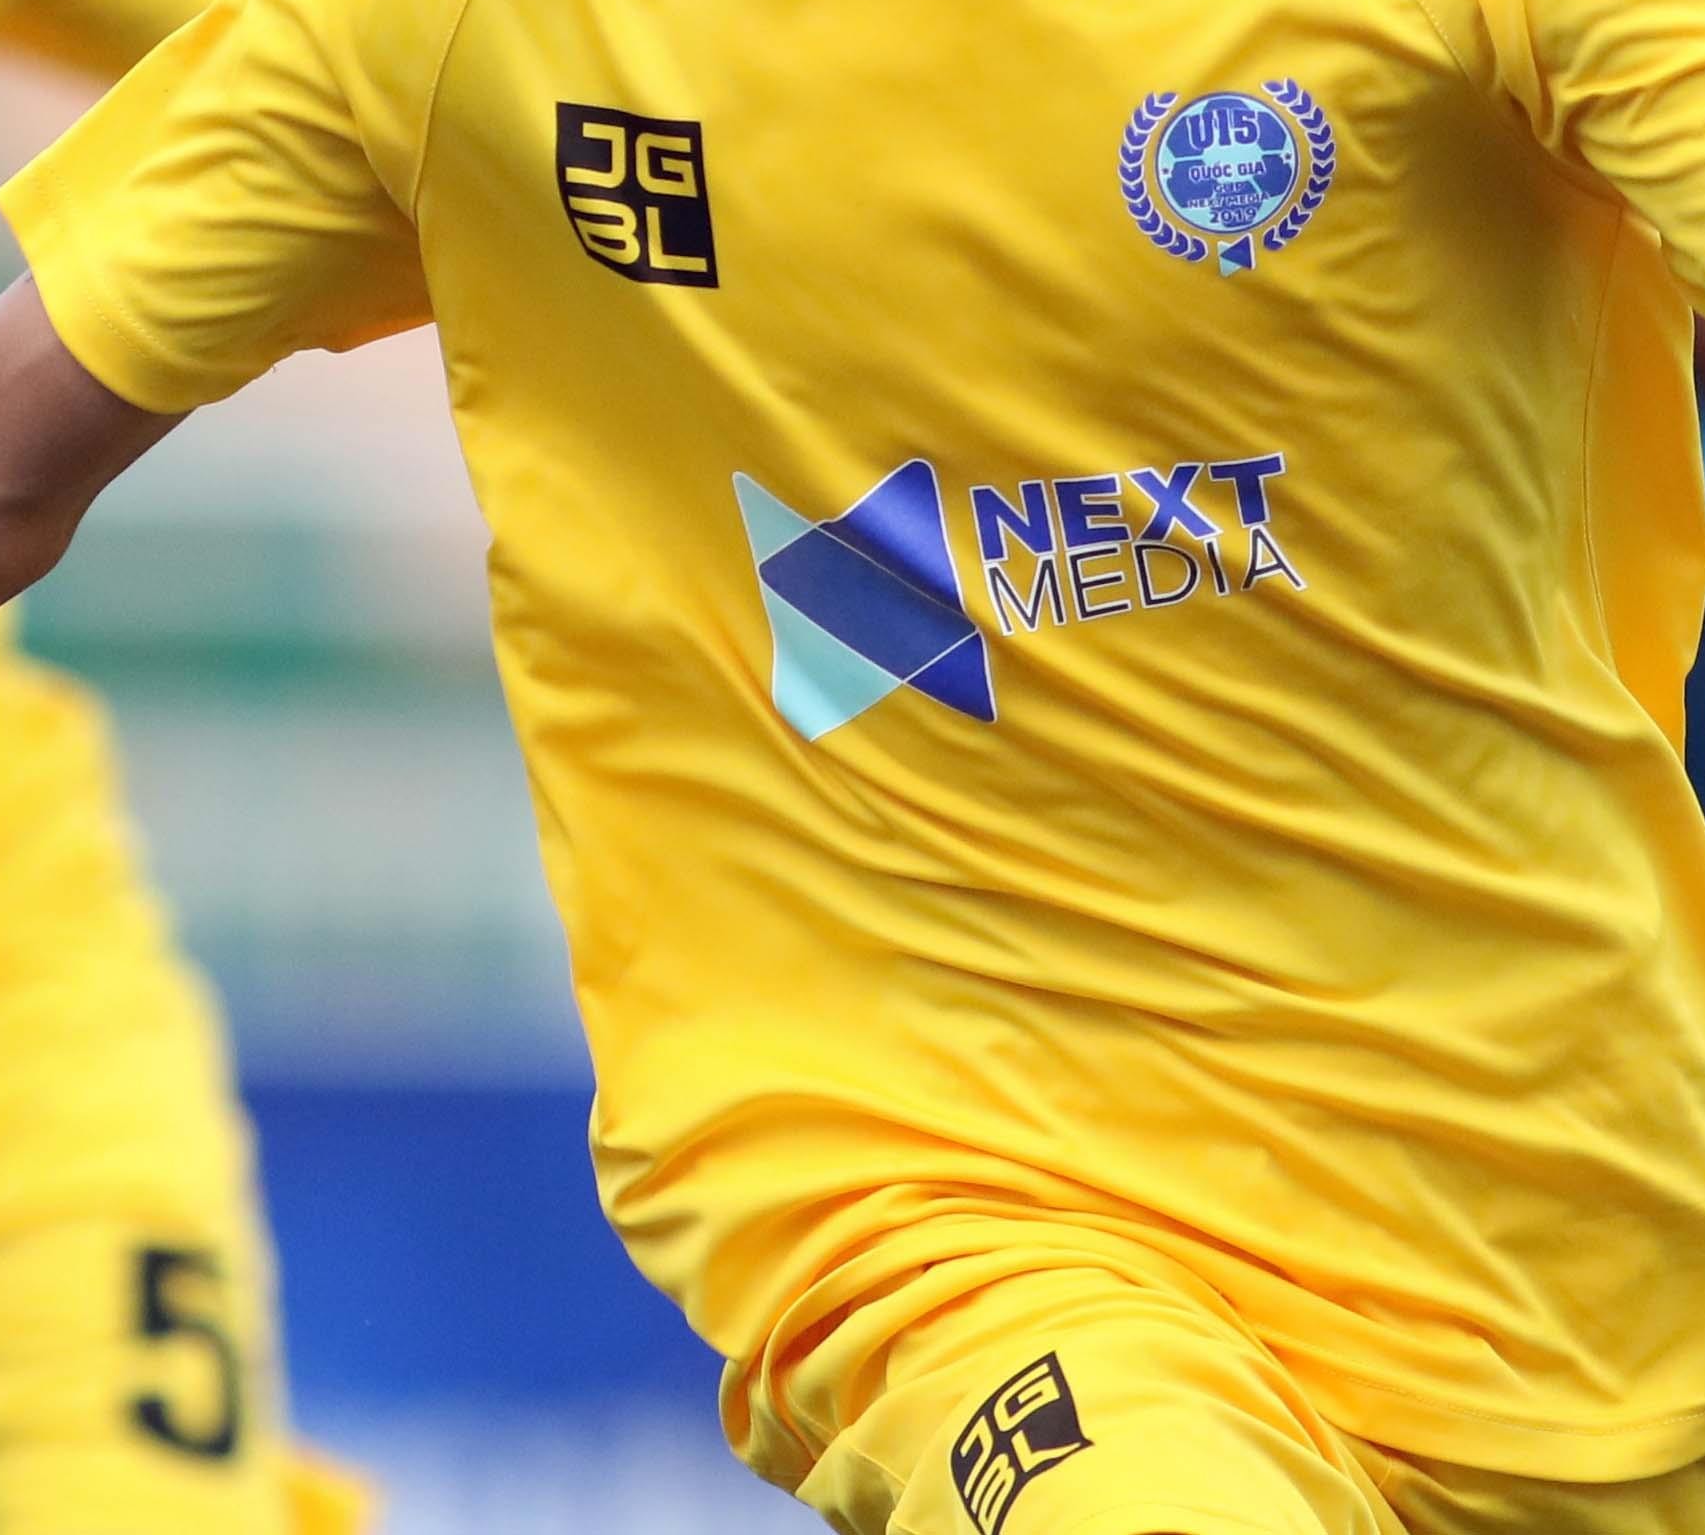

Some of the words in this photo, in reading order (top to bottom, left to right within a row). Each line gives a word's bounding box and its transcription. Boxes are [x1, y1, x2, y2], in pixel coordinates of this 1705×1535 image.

[565, 122, 698, 199] JG
[1186, 107, 1260, 151] U15
[1238, 160, 1267, 177] GIA
[1210, 207, 1258, 224] 2019
[969, 451, 1286, 565] NEXT
[984, 524, 1307, 636] MEDIA
[134, 1246, 240, 1459] 5
